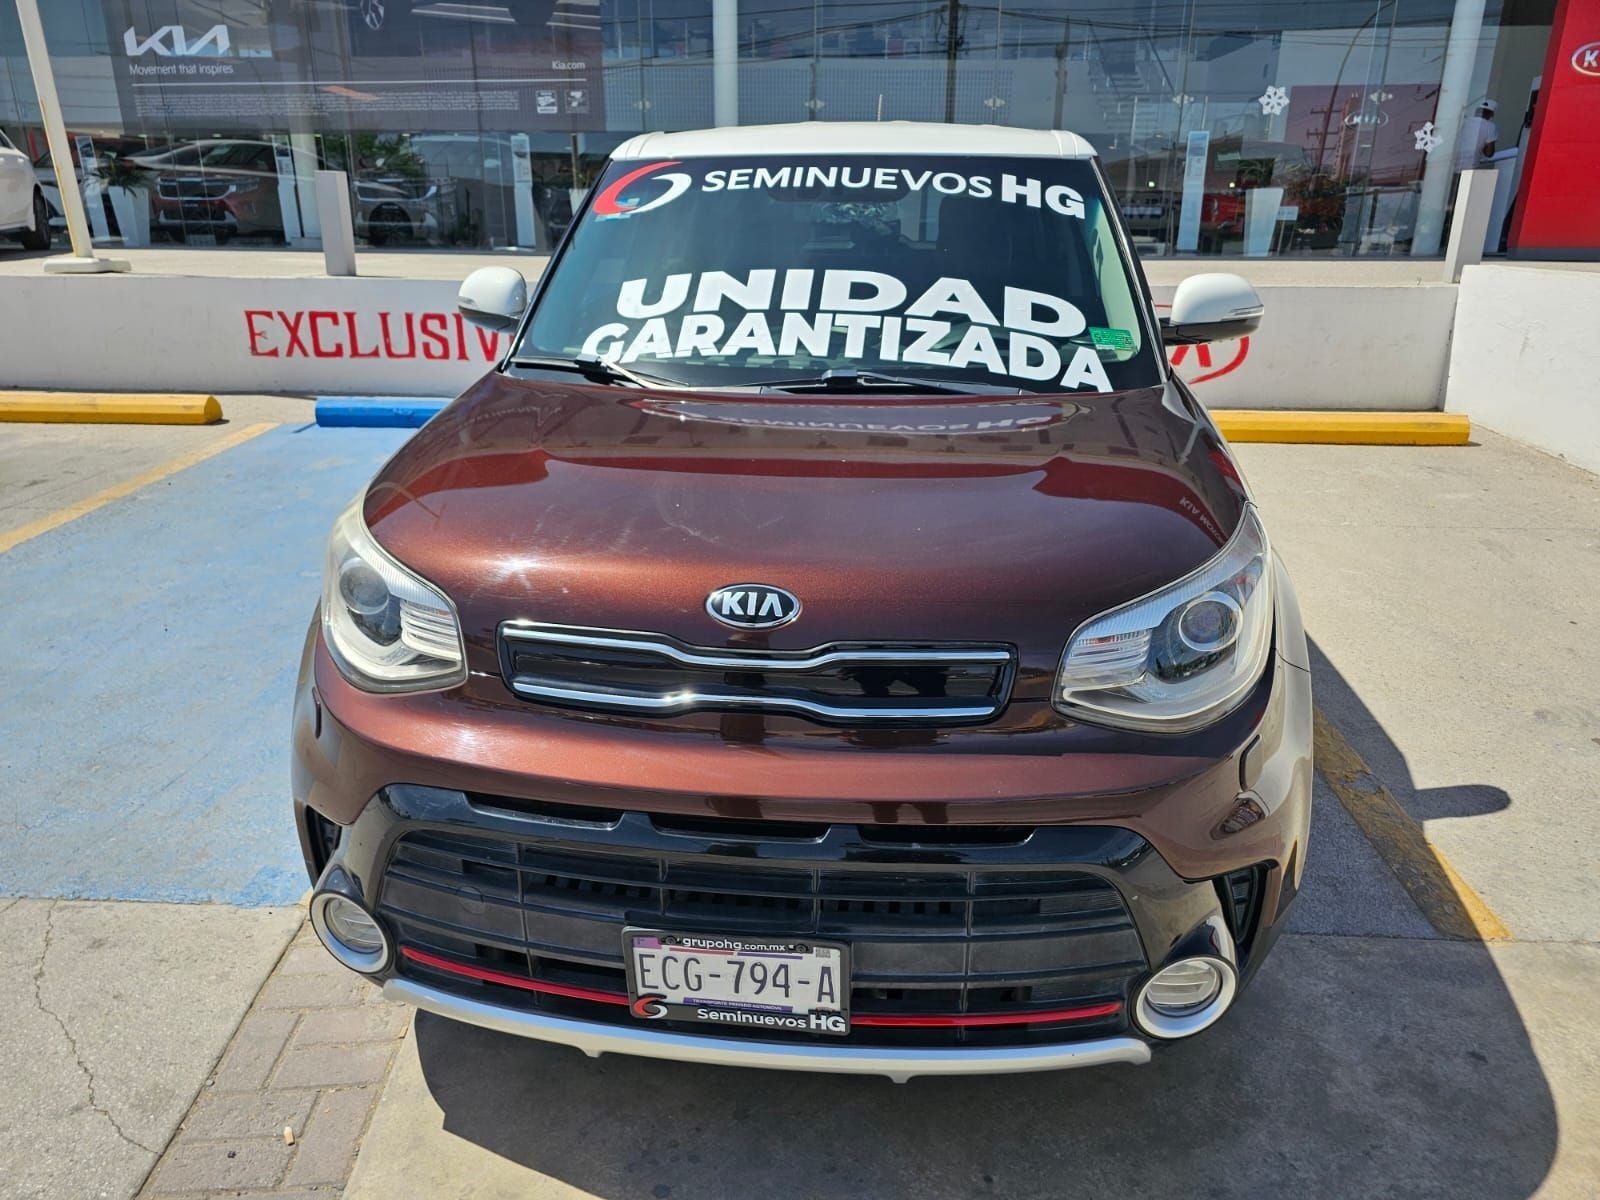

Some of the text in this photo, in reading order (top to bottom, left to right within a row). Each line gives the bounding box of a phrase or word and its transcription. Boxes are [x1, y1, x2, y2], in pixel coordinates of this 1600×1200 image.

[123, 24, 230, 56] KIA
[129, 64, 234, 75] Movement that inspires
[552, 60, 586, 70] Kia.com
[701, 166, 1086, 220] SEMINUEVOS HG
[617, 269, 1086, 338] UNIDAD
[245, 310, 513, 362] EXCLUSIV
[582, 312, 1114, 392] GARANTIZADA
[721, 591, 783, 617] KIA
[682, 937, 785, 951] grupohg.com.mx
[639, 953, 835, 1004] ECG-794-A
[697, 1008, 846, 1032] Seminuevos HG
